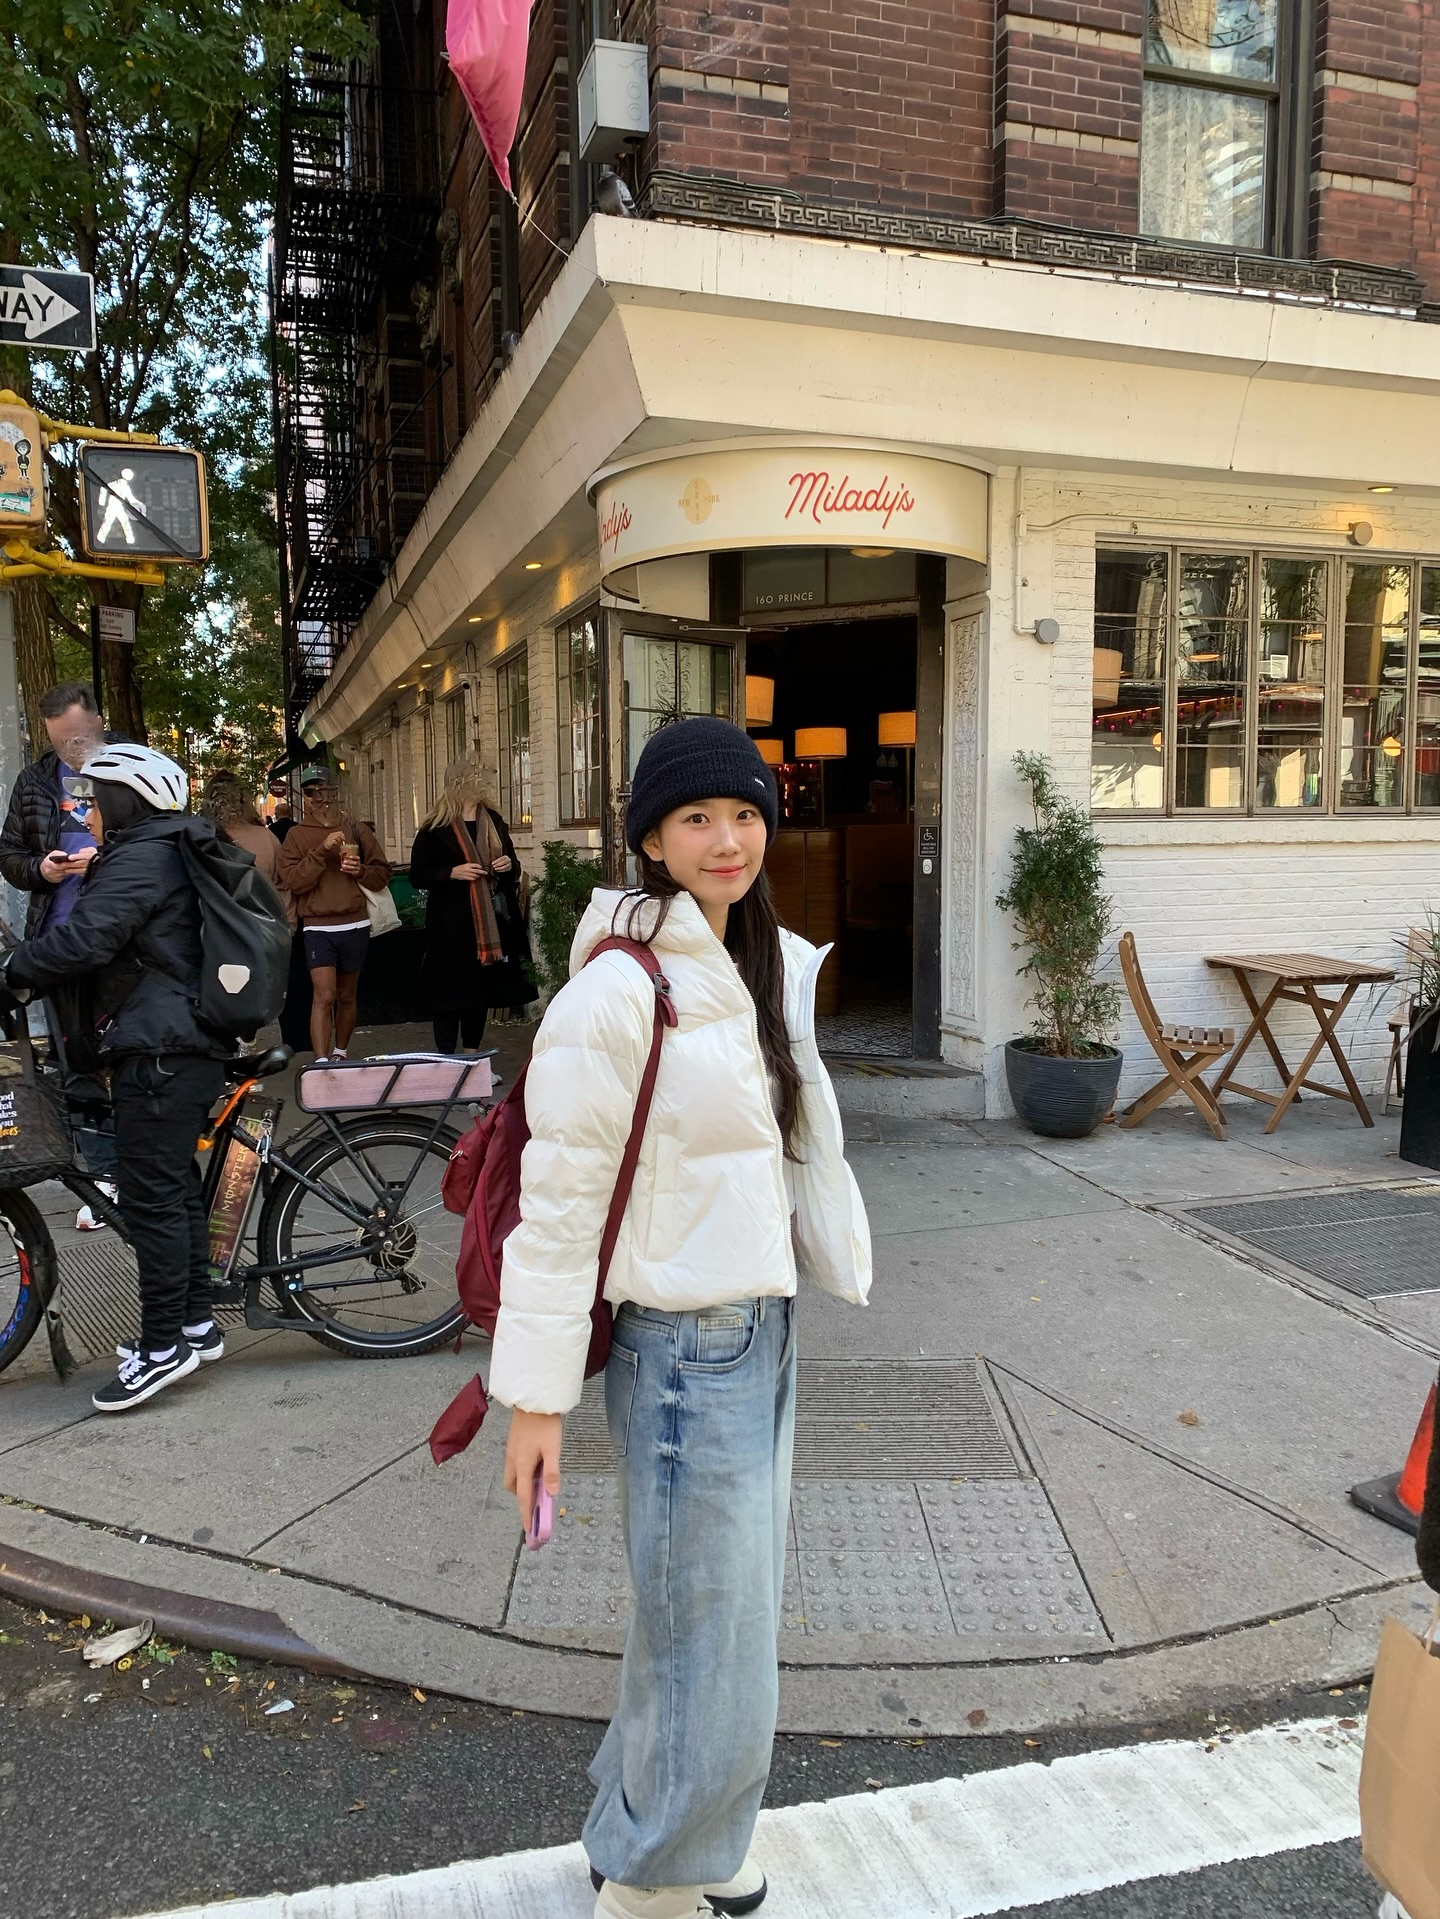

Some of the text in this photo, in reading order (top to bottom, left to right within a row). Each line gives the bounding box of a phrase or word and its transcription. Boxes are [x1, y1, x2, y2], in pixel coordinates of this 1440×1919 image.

[704, 494, 720, 504] YORK
[784, 472, 915, 529] Milady's
[755, 592, 813, 604] 160 PRINCE
[102, 610, 124, 619] PARKING
[221, 1145, 250, 1212] MONSTER
